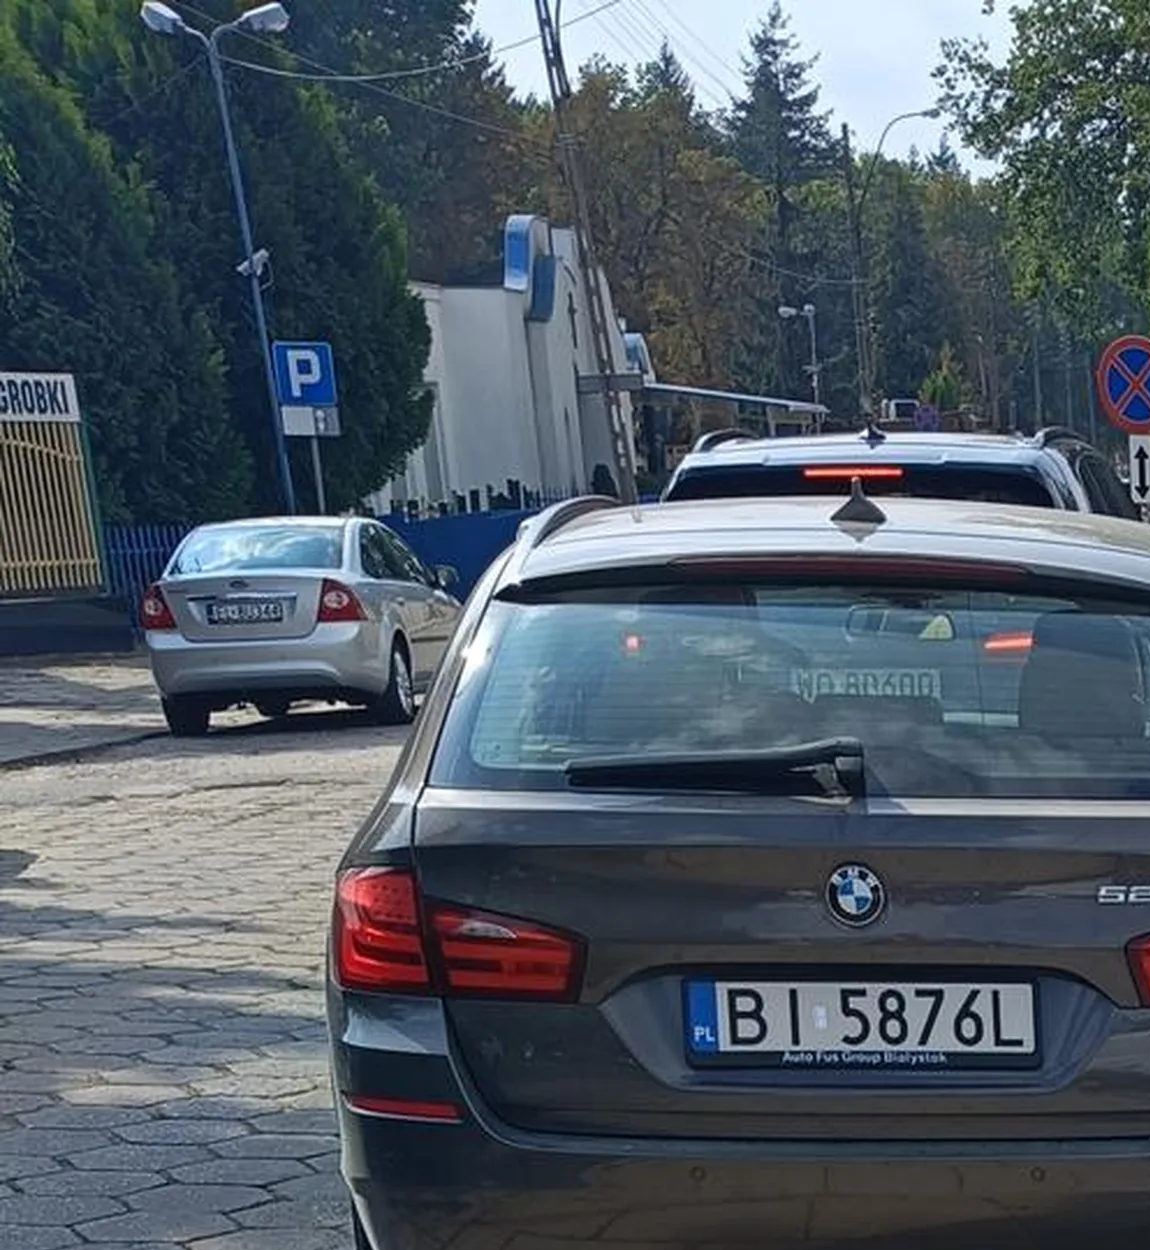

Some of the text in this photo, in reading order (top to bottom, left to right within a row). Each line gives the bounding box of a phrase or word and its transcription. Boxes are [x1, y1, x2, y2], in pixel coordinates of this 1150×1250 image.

[287, 349, 321, 397] P
[728, 988, 1024, 1047] BI 5876L
[694, 1026, 715, 1042] PL
[782, 1051, 814, 1064] Auto
[841, 1051, 881, 1065] Group
